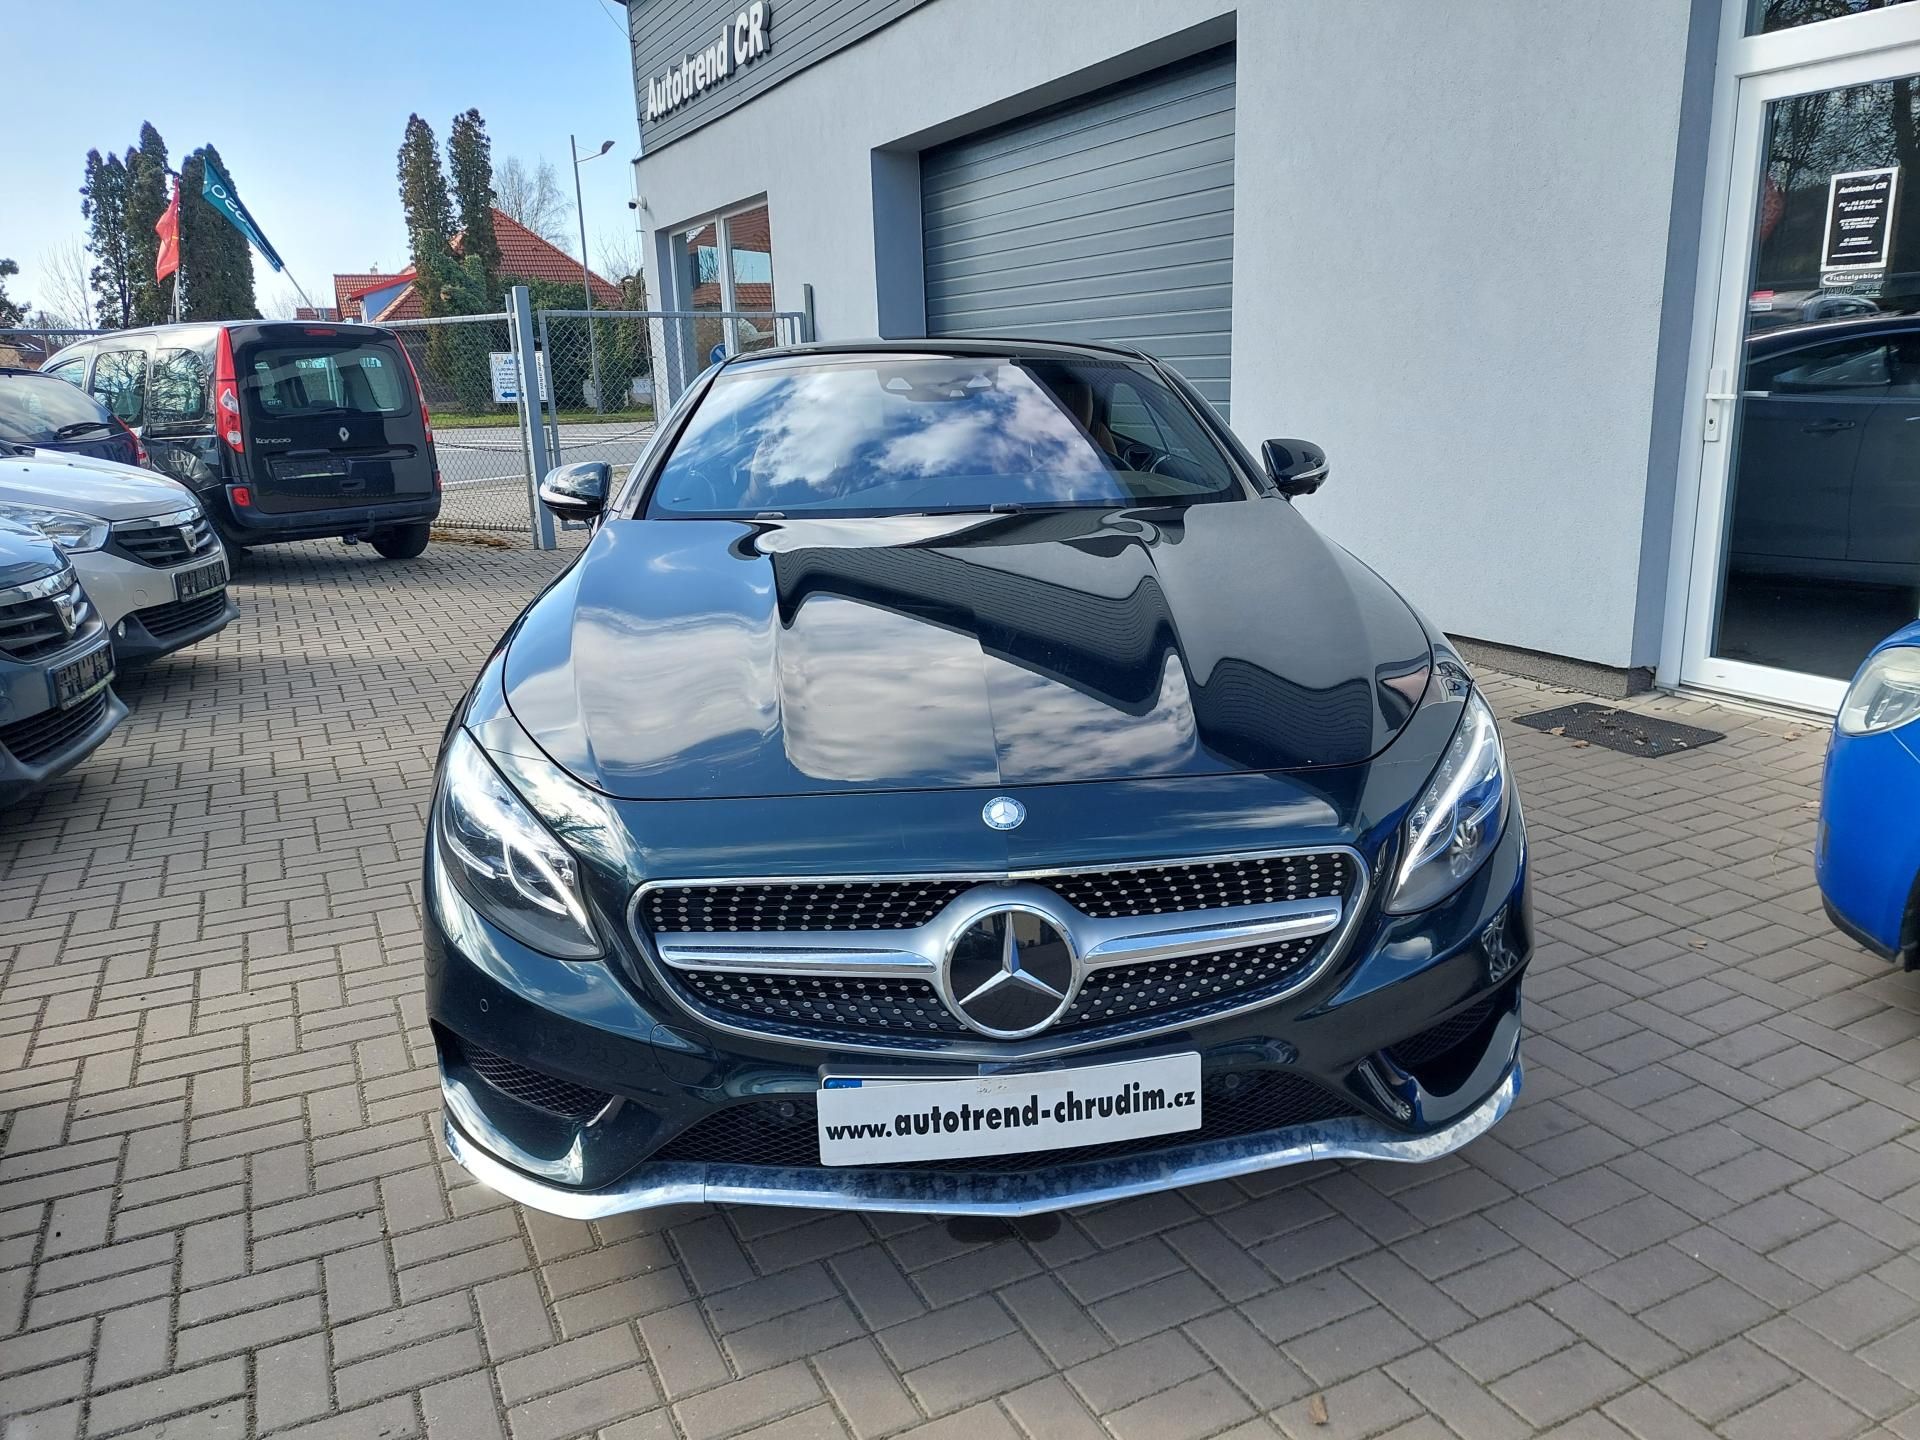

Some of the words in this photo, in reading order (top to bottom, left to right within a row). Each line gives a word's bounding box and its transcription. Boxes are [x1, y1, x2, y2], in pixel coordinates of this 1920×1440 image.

[646, 24, 730, 121] Autotrend
[734, 1, 767, 65] CR
[1838, 183, 1875, 194] Autotrend
[825, 1082, 1196, 1140] www.autotrend-chrudim.cz
